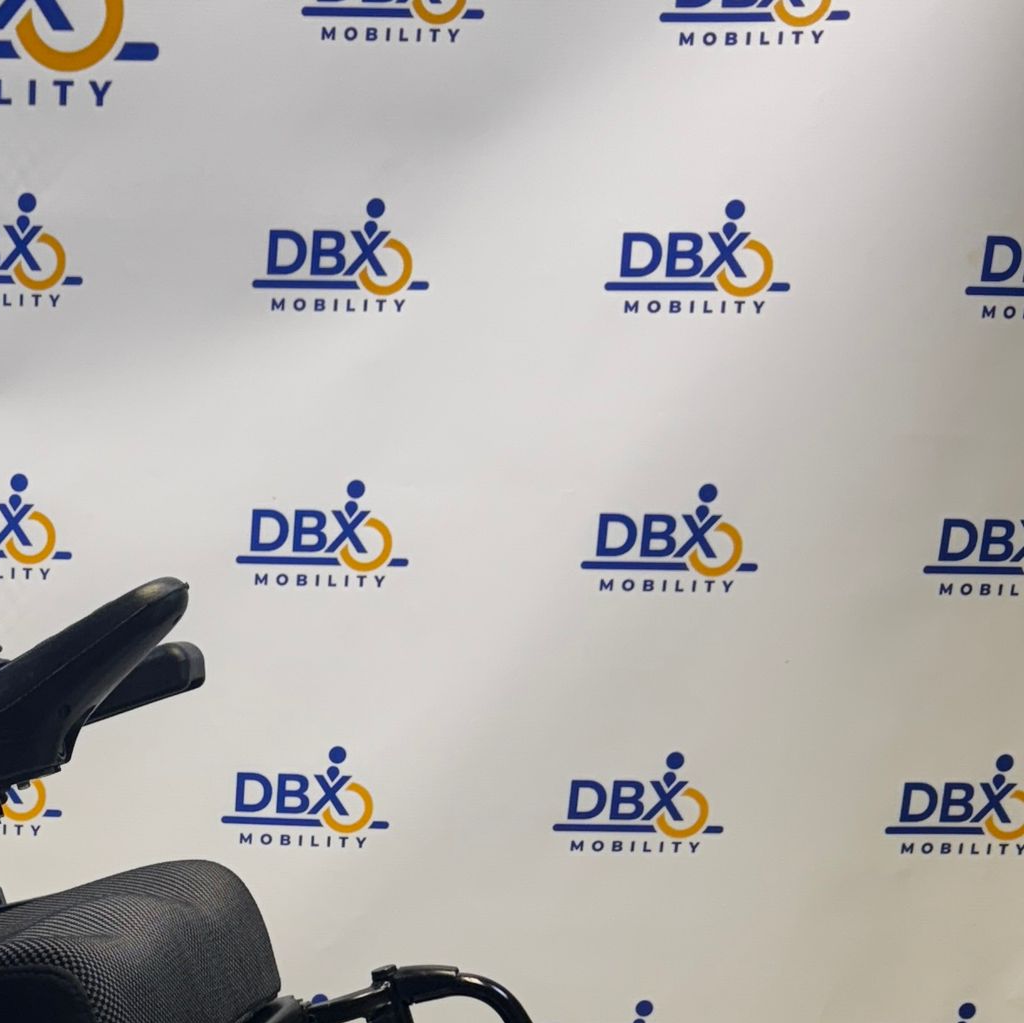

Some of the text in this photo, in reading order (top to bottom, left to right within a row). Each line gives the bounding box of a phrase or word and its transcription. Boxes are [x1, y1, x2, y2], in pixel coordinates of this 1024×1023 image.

[321, 26, 460, 43] MOBILITY
[679, 30, 824, 46] MOBILITY
[266, 229, 391, 276] DBX
[620, 232, 751, 278] DBX
[271, 297, 405, 312] MOBILITY
[624, 300, 765, 314] MOBILITY
[250, 509, 371, 554] DBX
[596, 513, 722, 558] DBX
[254, 573, 385, 588] MOBILITY
[599, 579, 734, 593] MOBILITY
[939, 583, 1019, 596] MOBIL
[235, 770, 352, 816] DBX
[567, 780, 688, 821] DBX
[899, 782, 1017, 823] DBX
[239, 833, 366, 848] MOBILITY
[570, 840, 700, 853] MOBILITY
[901, 842, 1024, 856] MOBILITY
